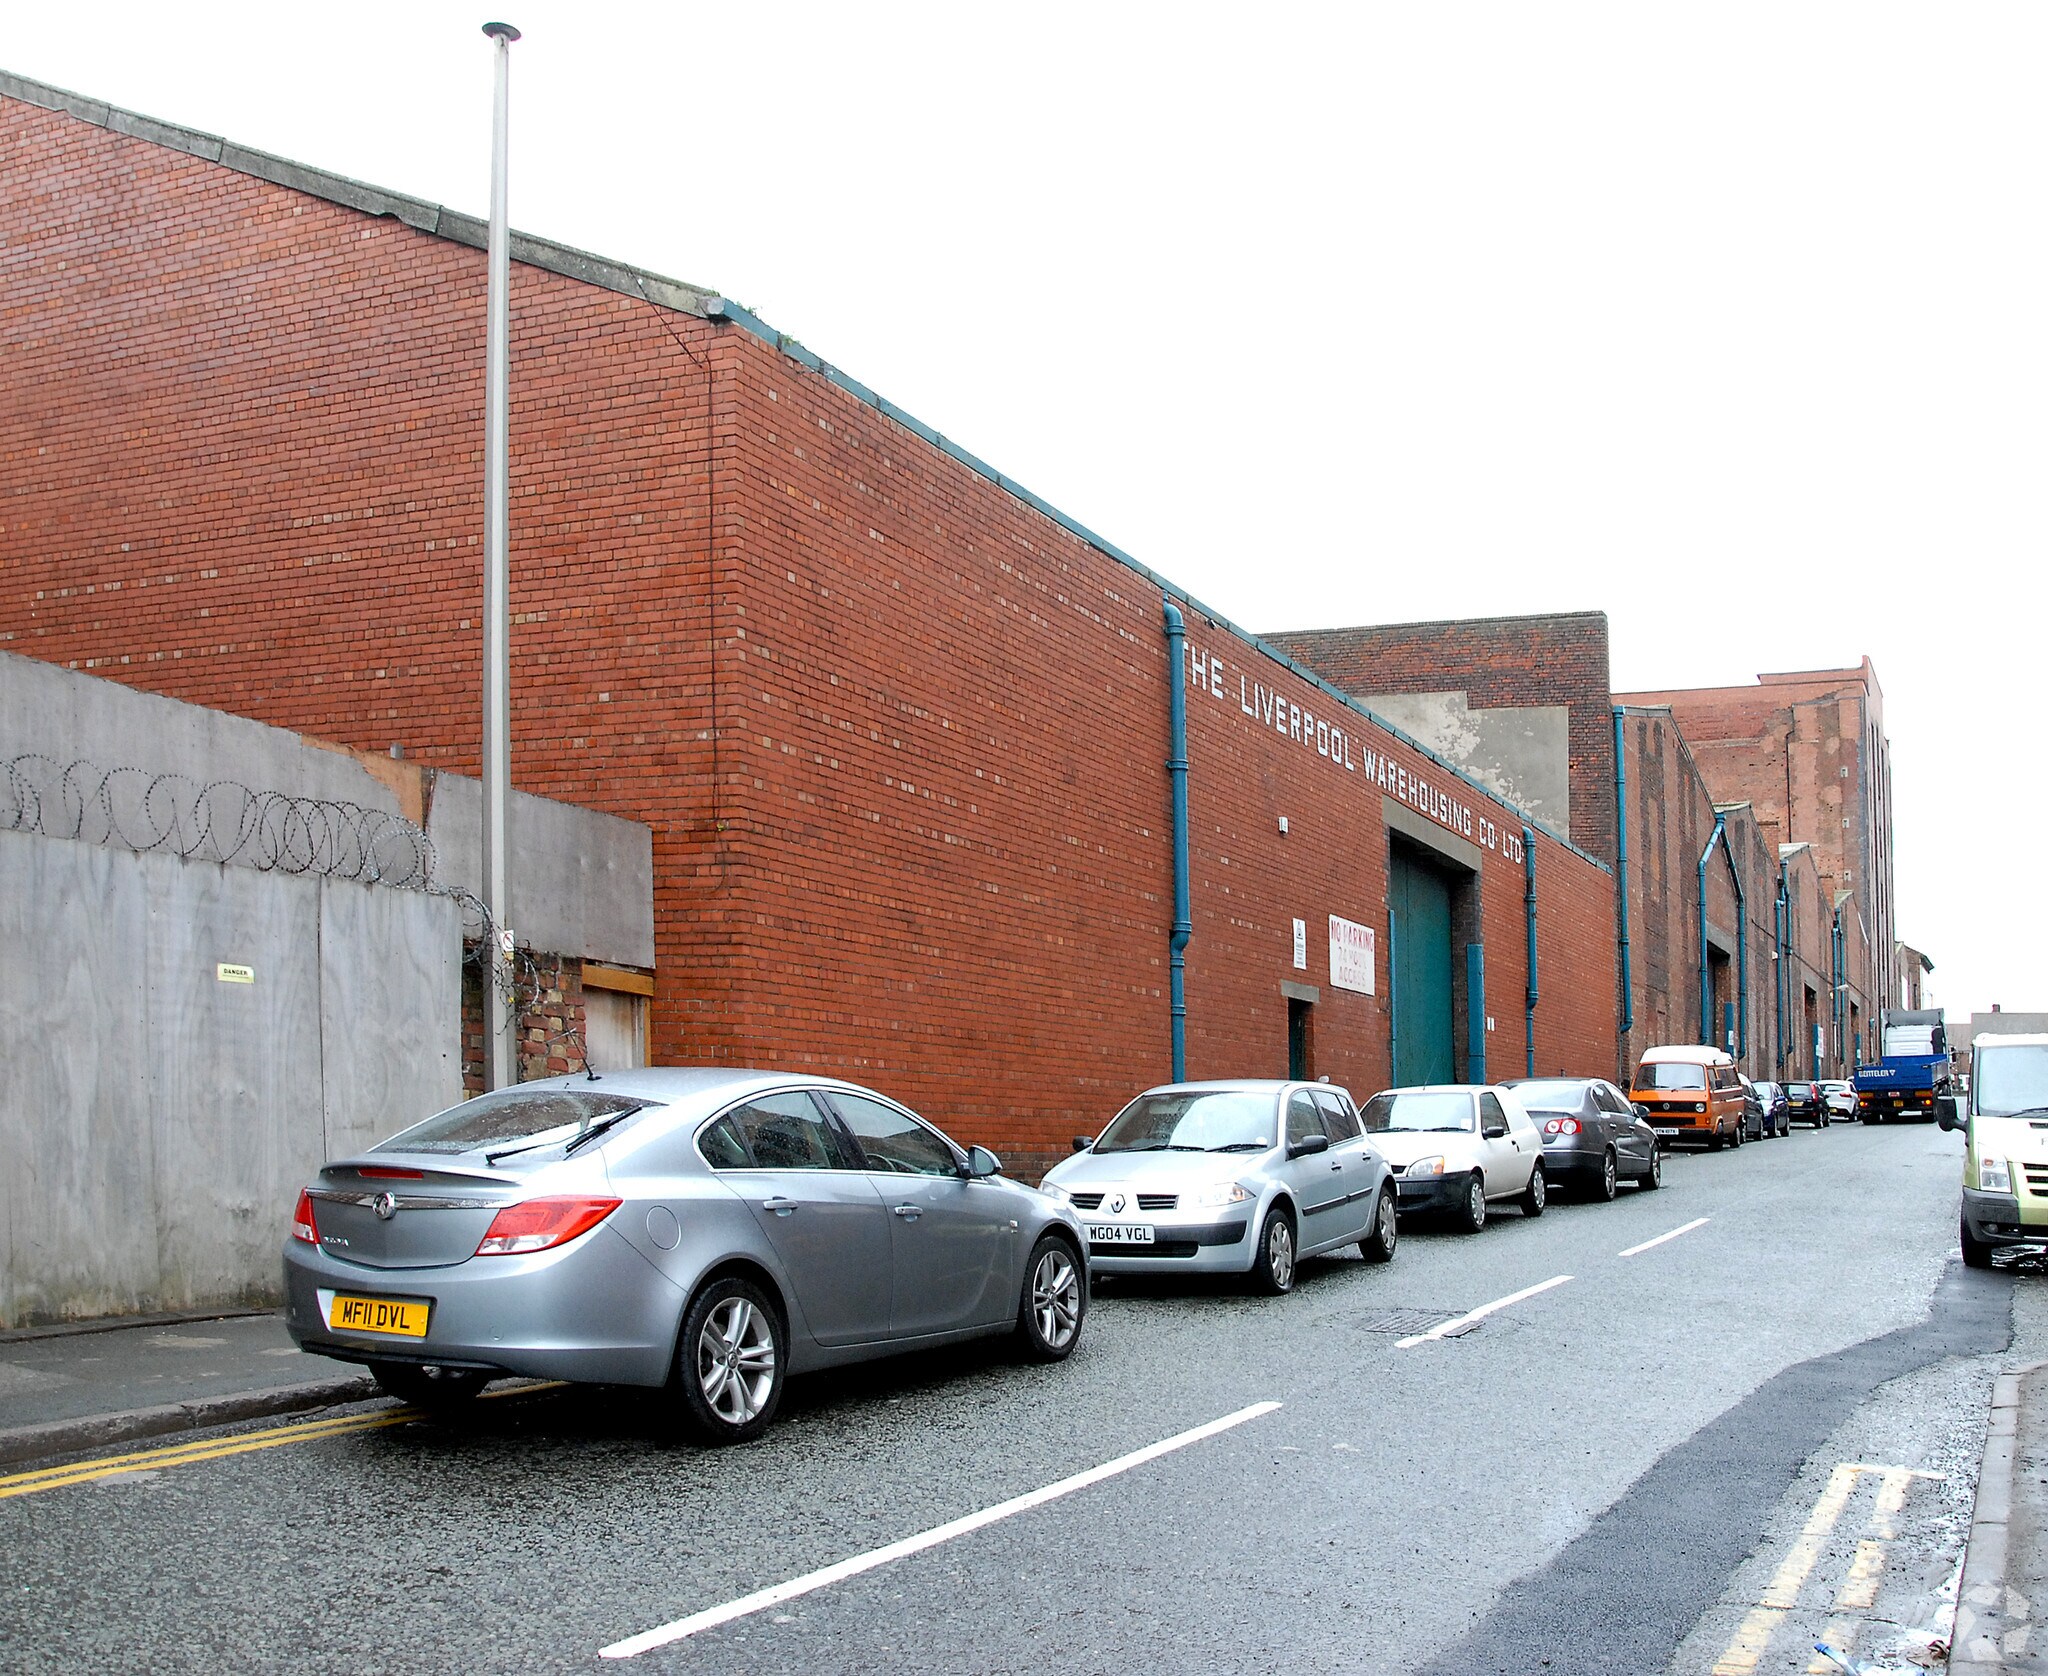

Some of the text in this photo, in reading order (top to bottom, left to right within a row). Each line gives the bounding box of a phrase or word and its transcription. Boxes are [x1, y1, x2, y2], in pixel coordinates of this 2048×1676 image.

[1184, 641, 1223, 699] HE
[1241, 675, 1354, 772] LIVERPOOL
[1363, 746, 1471, 837] WAREHOUSING
[1331, 920, 1374, 953] NO PARKING
[223, 968, 249, 976] DANGER
[1090, 1226, 1152, 1241] WG04 VGL
[342, 1301, 410, 1330] MF11 DVL
